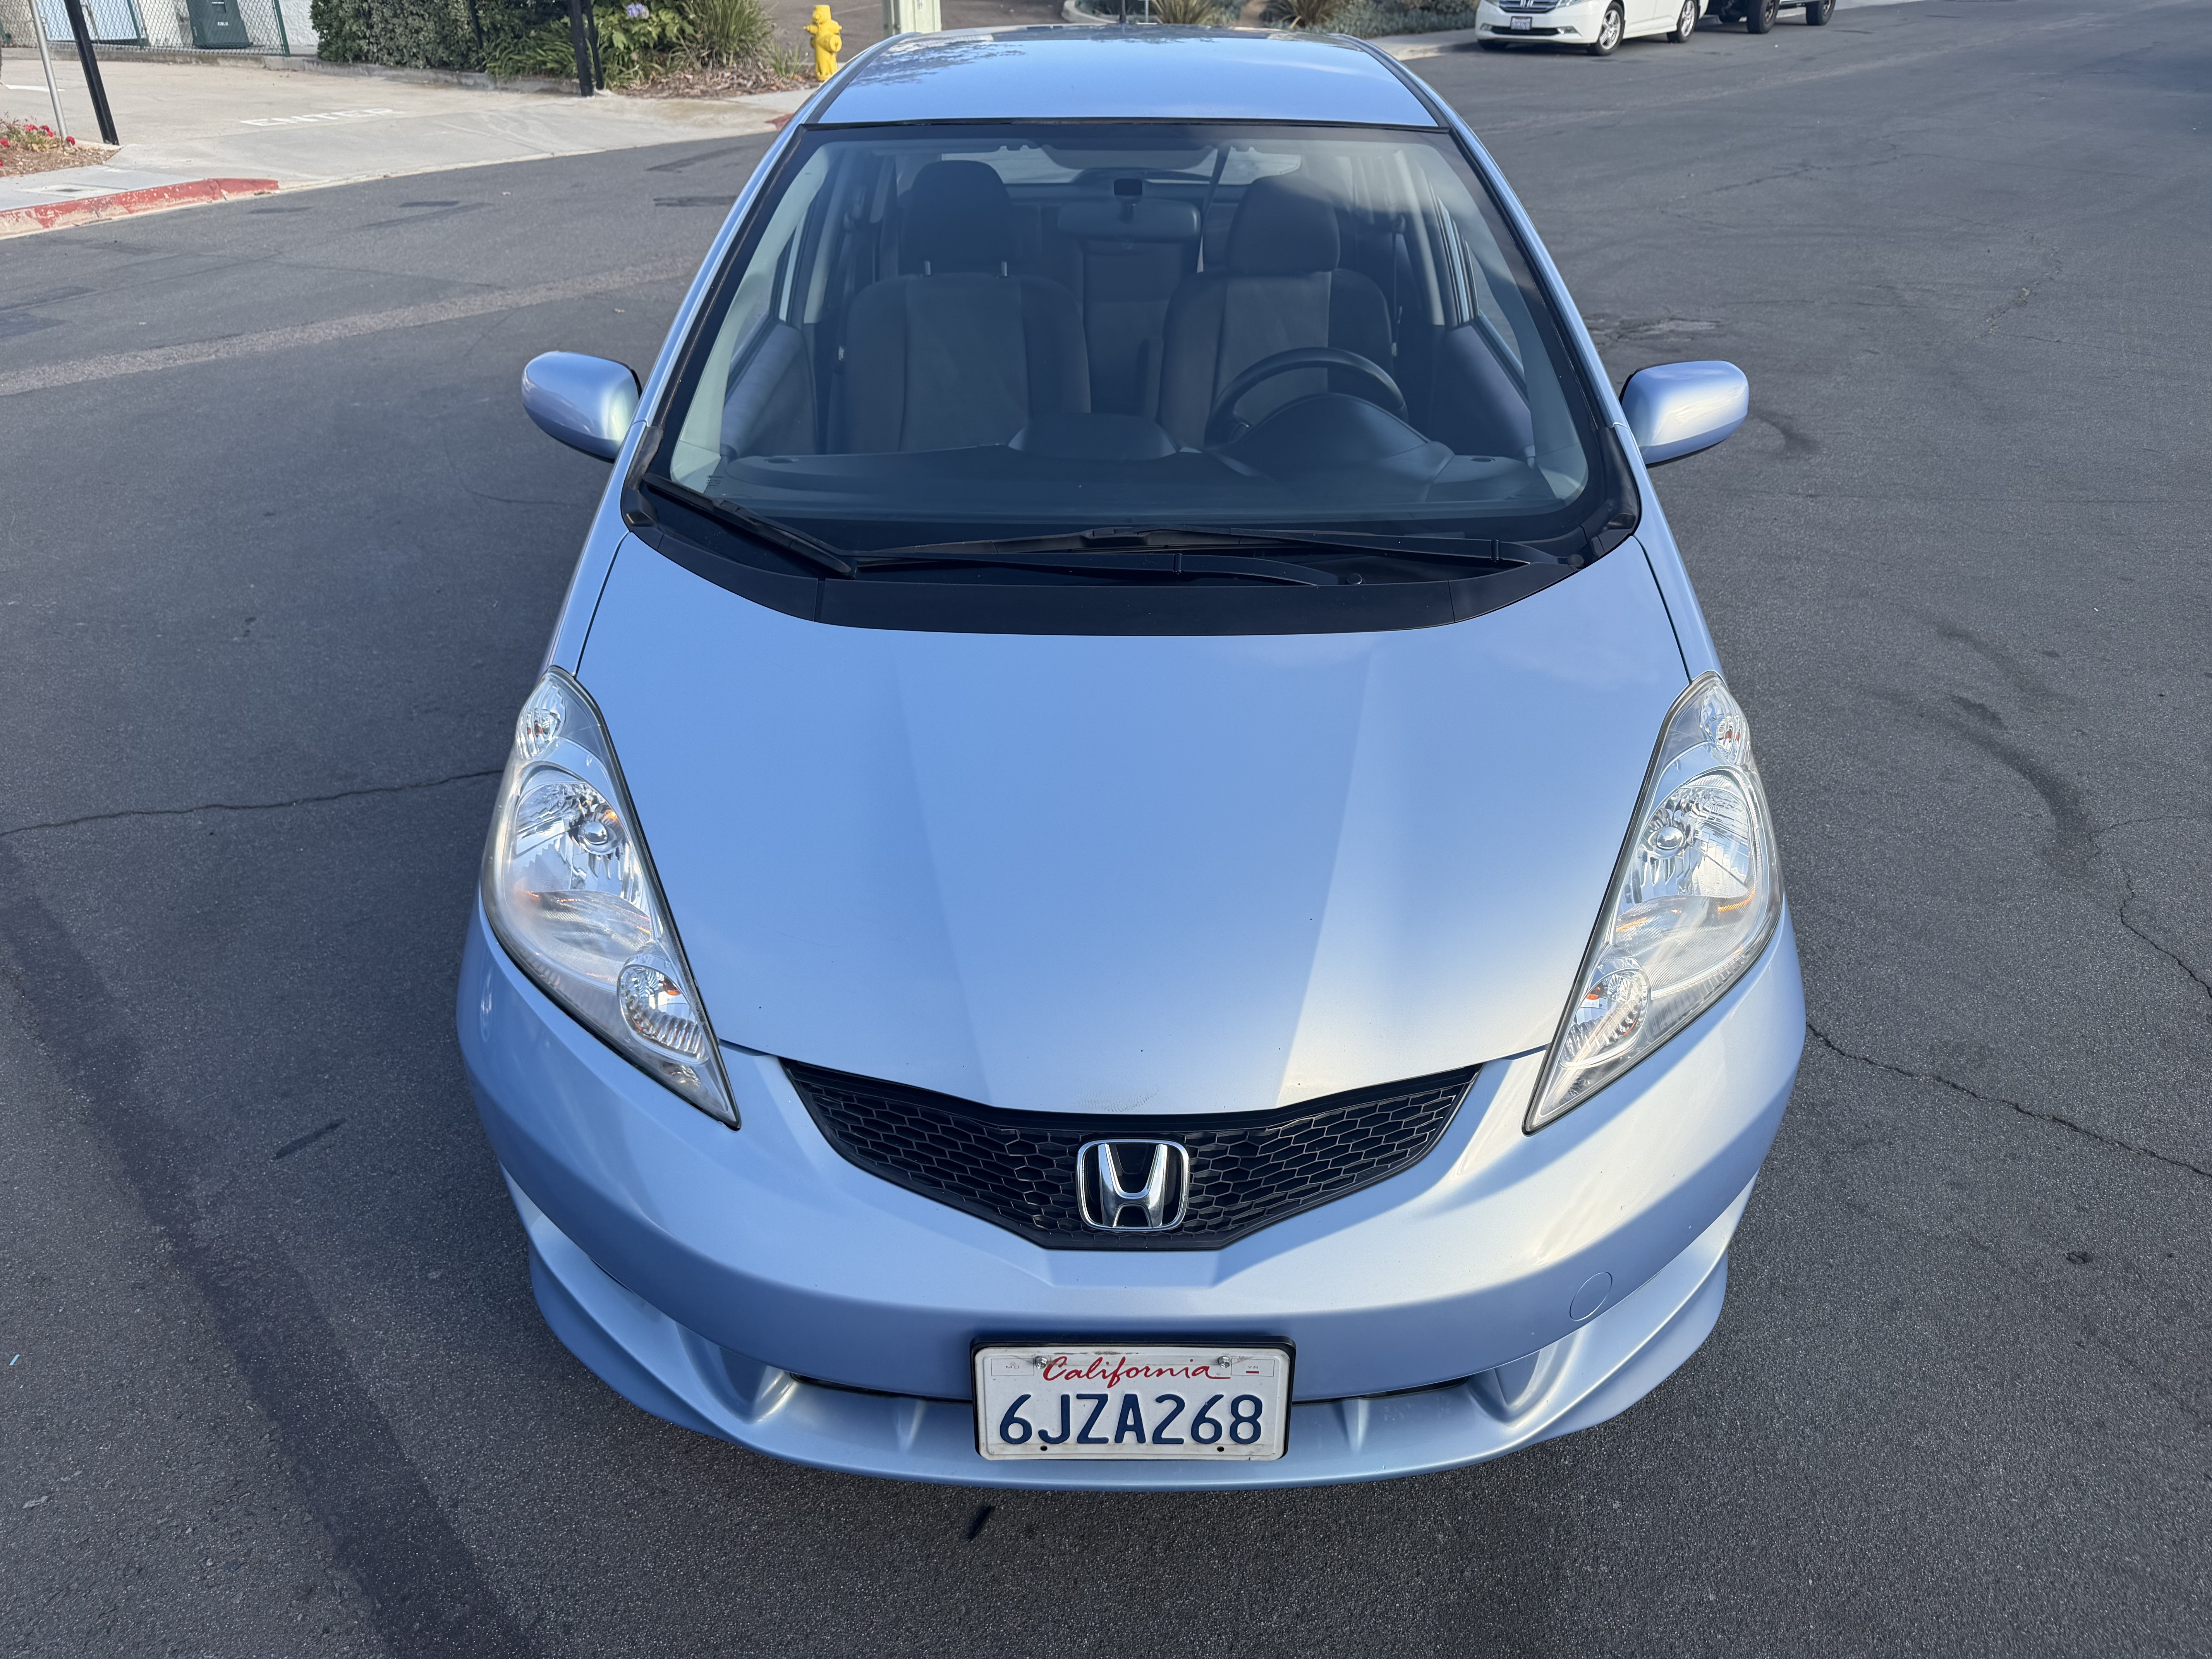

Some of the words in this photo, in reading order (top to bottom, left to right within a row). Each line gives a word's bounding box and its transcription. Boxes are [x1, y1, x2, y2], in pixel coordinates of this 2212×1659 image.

[240, 108, 405, 126] ENTER
[1042, 1356, 1231, 1388] California
[1000, 1393, 1263, 1445] 6JZA268
